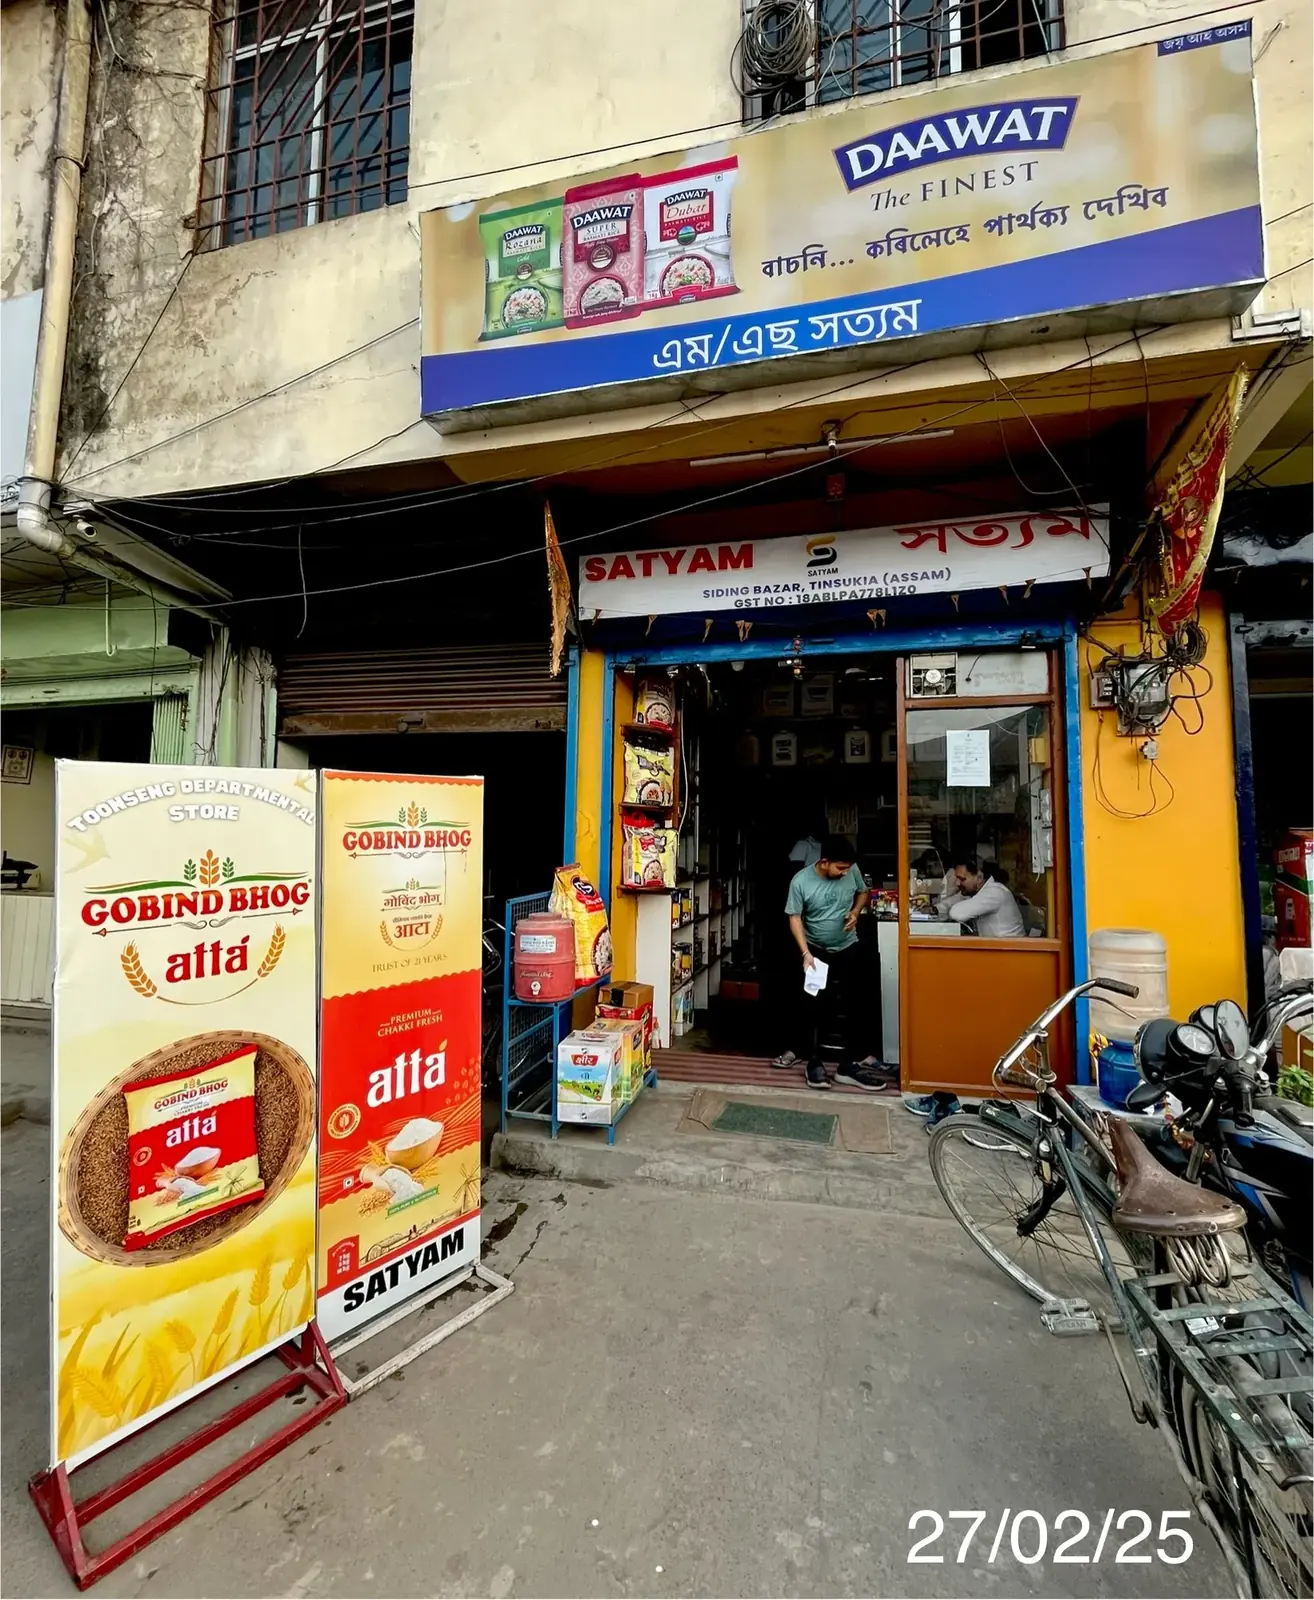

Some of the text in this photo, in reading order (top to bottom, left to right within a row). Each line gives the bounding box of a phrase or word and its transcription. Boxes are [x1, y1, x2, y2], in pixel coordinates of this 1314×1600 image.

[845, 107, 1067, 180] DAAWAT
[667, 190, 707, 205] DAAWAT
[870, 161, 1039, 211] The FINEST
[573, 206, 631, 229] DAAWAT
[666, 203, 707, 219] Dubar
[1083, 184, 1170, 221] দেখিব
[505, 225, 543, 240] DAAWAT
[587, 222, 617, 235] SUPER
[653, 299, 923, 369] এম/এছ সত্যম
[893, 510, 1091, 554] সত্যম
[584, 543, 754, 582] SATYAM
[807, 567, 839, 577] SATYAM
[703, 567, 951, 599] SIDING BAZAR, TINSUKIA (ASSAM)
[734, 597, 760, 608] GST
[765, 596, 785, 607] NO
[66, 779, 315, 833] TOONSENG DEPARTMENTAL
[168, 804, 240, 822] STORE
[343, 829, 472, 851] GOBIND BHOG
[81, 882, 311, 927] GOBIND BHOG
[393, 921, 431, 939] आटा
[166, 935, 250, 984] atta
[372, 961, 398, 973] TRUST
[378, 1014, 443, 1037] CHAKKI FRESH
[390, 1008, 432, 1025] PREMIUM
[367, 1040, 447, 1108] atta
[154, 1078, 228, 1110] GOBIND BHOG
[166, 1110, 217, 1148] atta
[343, 1228, 465, 1314] SATYAM
